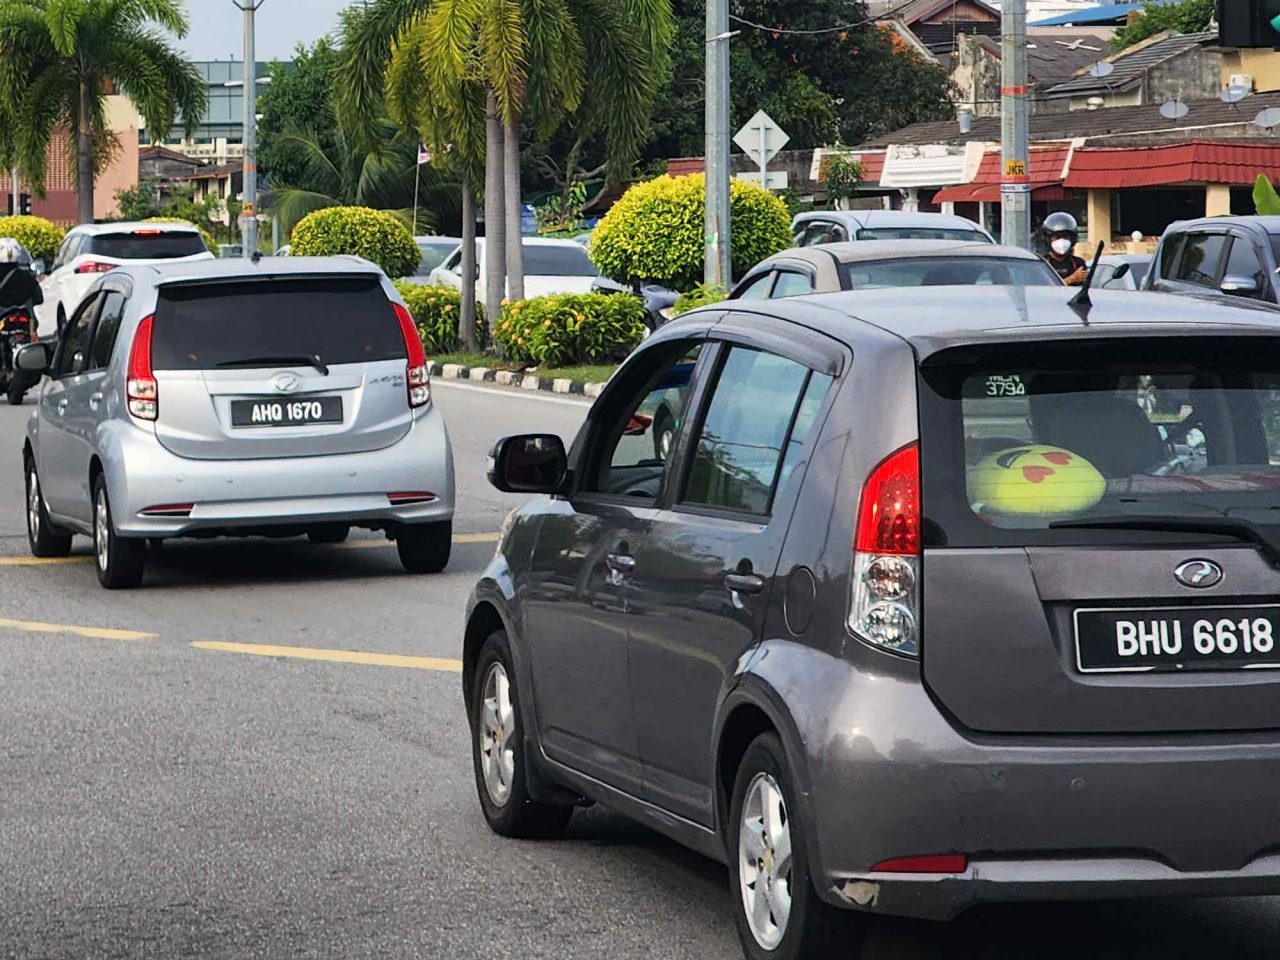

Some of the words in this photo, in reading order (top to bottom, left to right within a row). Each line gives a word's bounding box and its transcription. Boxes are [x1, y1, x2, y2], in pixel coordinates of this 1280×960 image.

[1006, 164, 1025, 176] JKR
[985, 381, 1026, 396] 3794
[251, 404, 283, 422] AHQ
[286, 401, 322, 420] 1670
[1115, 620, 1183, 657] BHU
[1192, 617, 1274, 655] 6618
